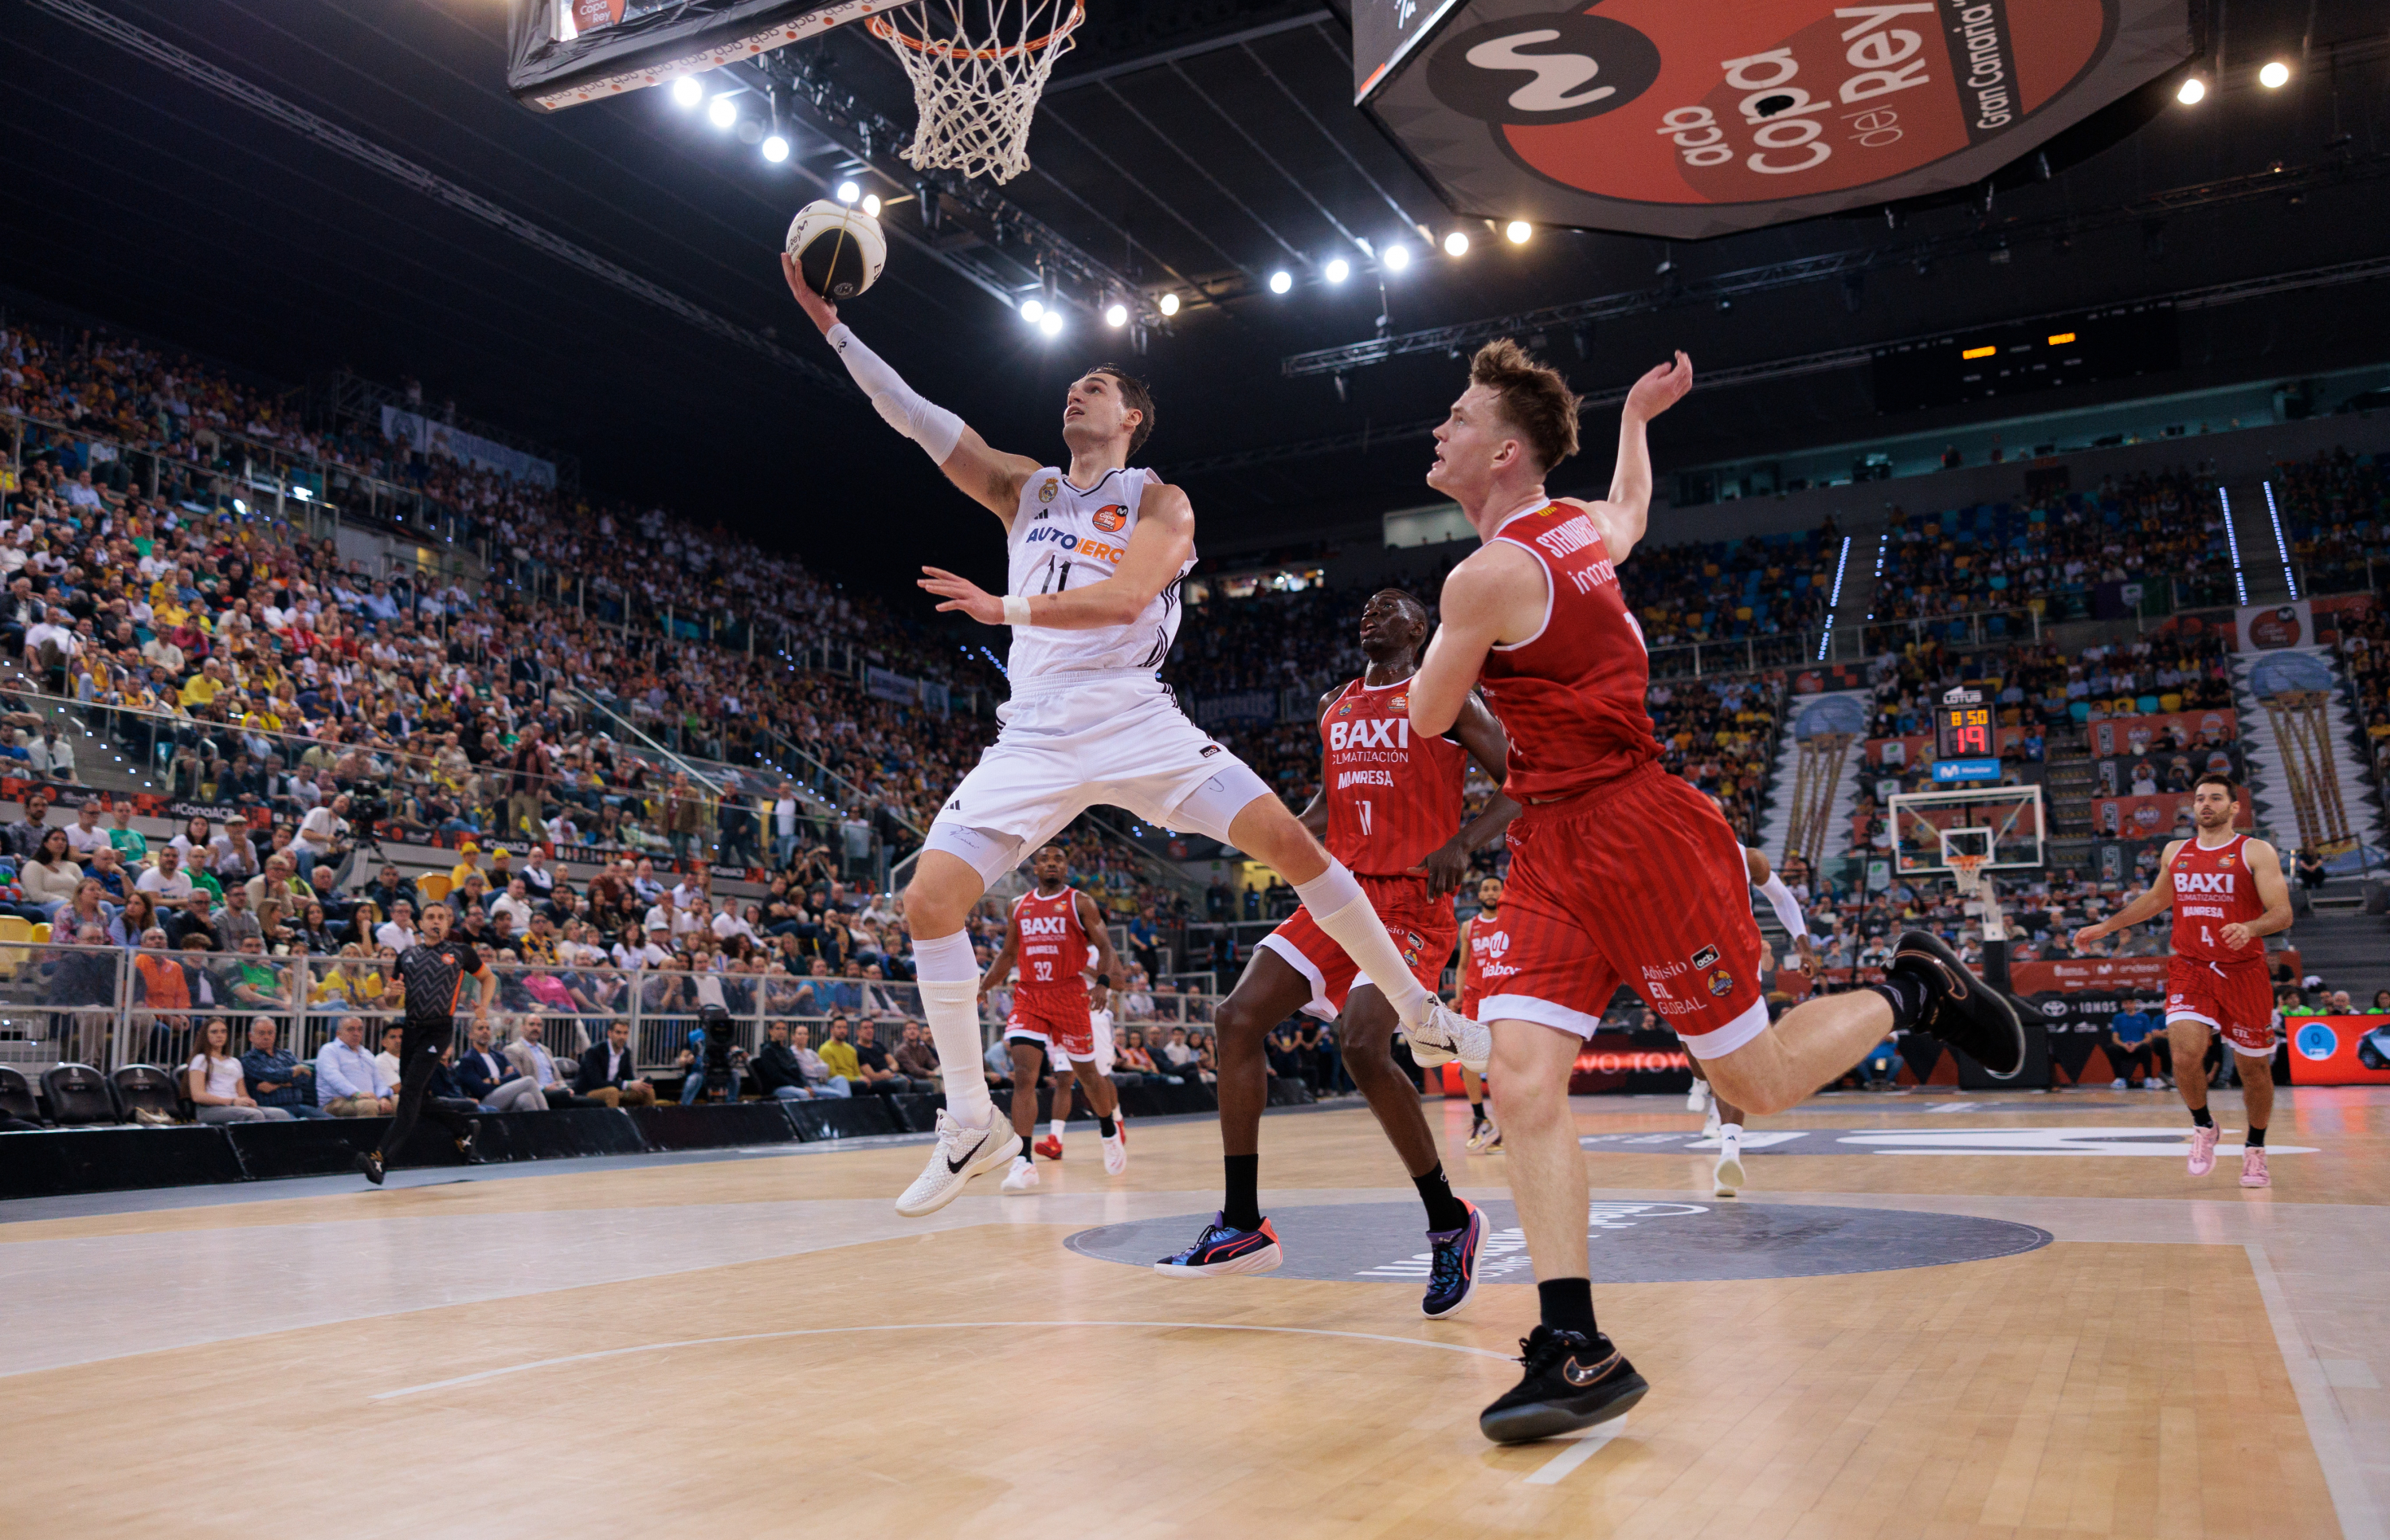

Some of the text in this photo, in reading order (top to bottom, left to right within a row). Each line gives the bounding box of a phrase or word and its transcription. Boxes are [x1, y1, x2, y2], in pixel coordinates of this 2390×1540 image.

[580, 1, 607, 15] Copa
[593, 10, 611, 23] Rey
[1834, 2, 1934, 147] del Rey
[1953, 3, 2012, 130] Gran Canaria
[1721, 47, 1832, 174] Copa
[1656, 105, 1734, 167] acb
[1040, 554, 1072, 595] 11
[1330, 719, 1409, 751] BAXI
[1957, 726, 1985, 753] 19
[1204, 748, 1217, 757] acb
[1338, 770, 1393, 790] MANRESA
[2173, 873, 2235, 893] BAXI
[2182, 906, 2224, 919] MANRESA
[1020, 917, 1066, 936] BAXI
[2201, 926, 2214, 947] 4
[1697, 954, 1714, 966] acb
[1034, 961, 1054, 982] 32
[1648, 982, 1673, 999] ETL
[1657, 997, 1707, 1015] GLOBAL
